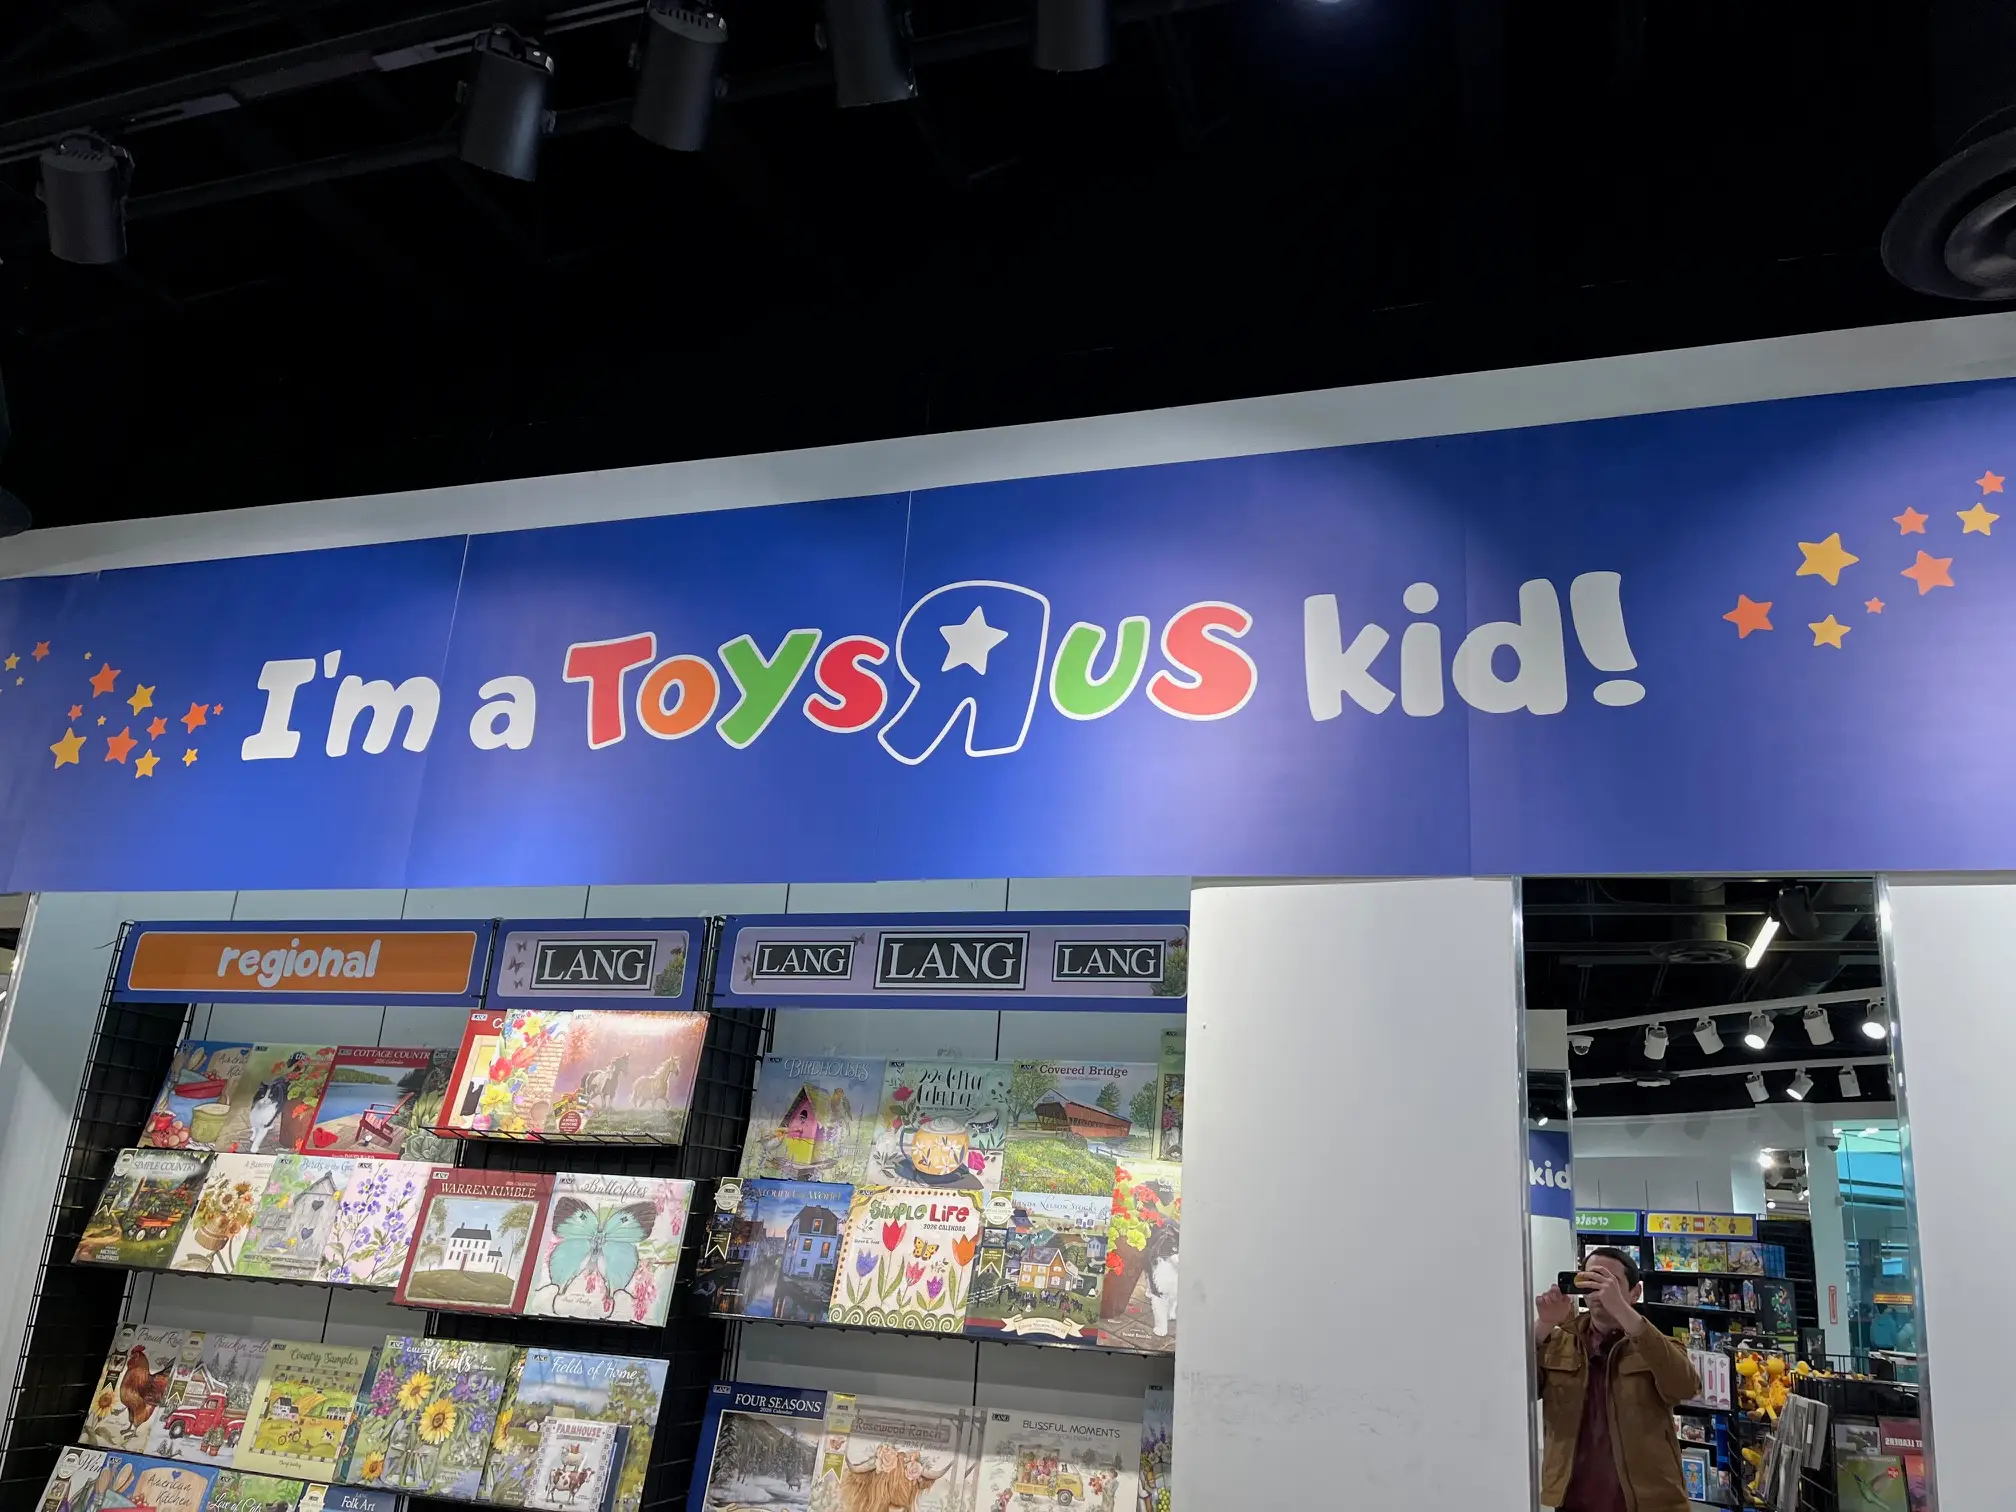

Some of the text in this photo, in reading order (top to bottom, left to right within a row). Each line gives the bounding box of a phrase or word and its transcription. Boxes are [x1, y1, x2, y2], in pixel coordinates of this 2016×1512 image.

[241, 650, 441, 761] I'm
[469, 675, 538, 751] a
[1302, 570, 1647, 725] kid!
[217, 937, 381, 987] regional
[540, 949, 646, 982] LANG
[760, 947, 848, 974] LANG
[885, 941, 1017, 981] LANG
[1058, 946, 1157, 976] LANG
[352, 1049, 431, 1061] COTTAGE COUNTR
[1039, 1064, 1128, 1079] Covered Bridge
[133, 1160, 198, 1173] SIMPLE COUNTRY
[440, 1182, 537, 1199] WARREN KIMBLE
[580, 1179, 648, 1203] Butterflies
[290, 1349, 359, 1368] Country Sampler
[551, 1356, 639, 1380] Fields of Home
[713, 1385, 731, 1393] LANG
[735, 1393, 823, 1414] FOUR SEASONS
[556, 1422, 603, 1438] FARMHOUSE
[855, 1417, 942, 1440] Rosewood Ranch
[1022, 1419, 1121, 1439] BLISSFUL MOMENTS
[147, 1473, 192, 1492] American
[155, 1490, 192, 1507] Kitchen
[341, 1495, 375, 1512] Folk Art
